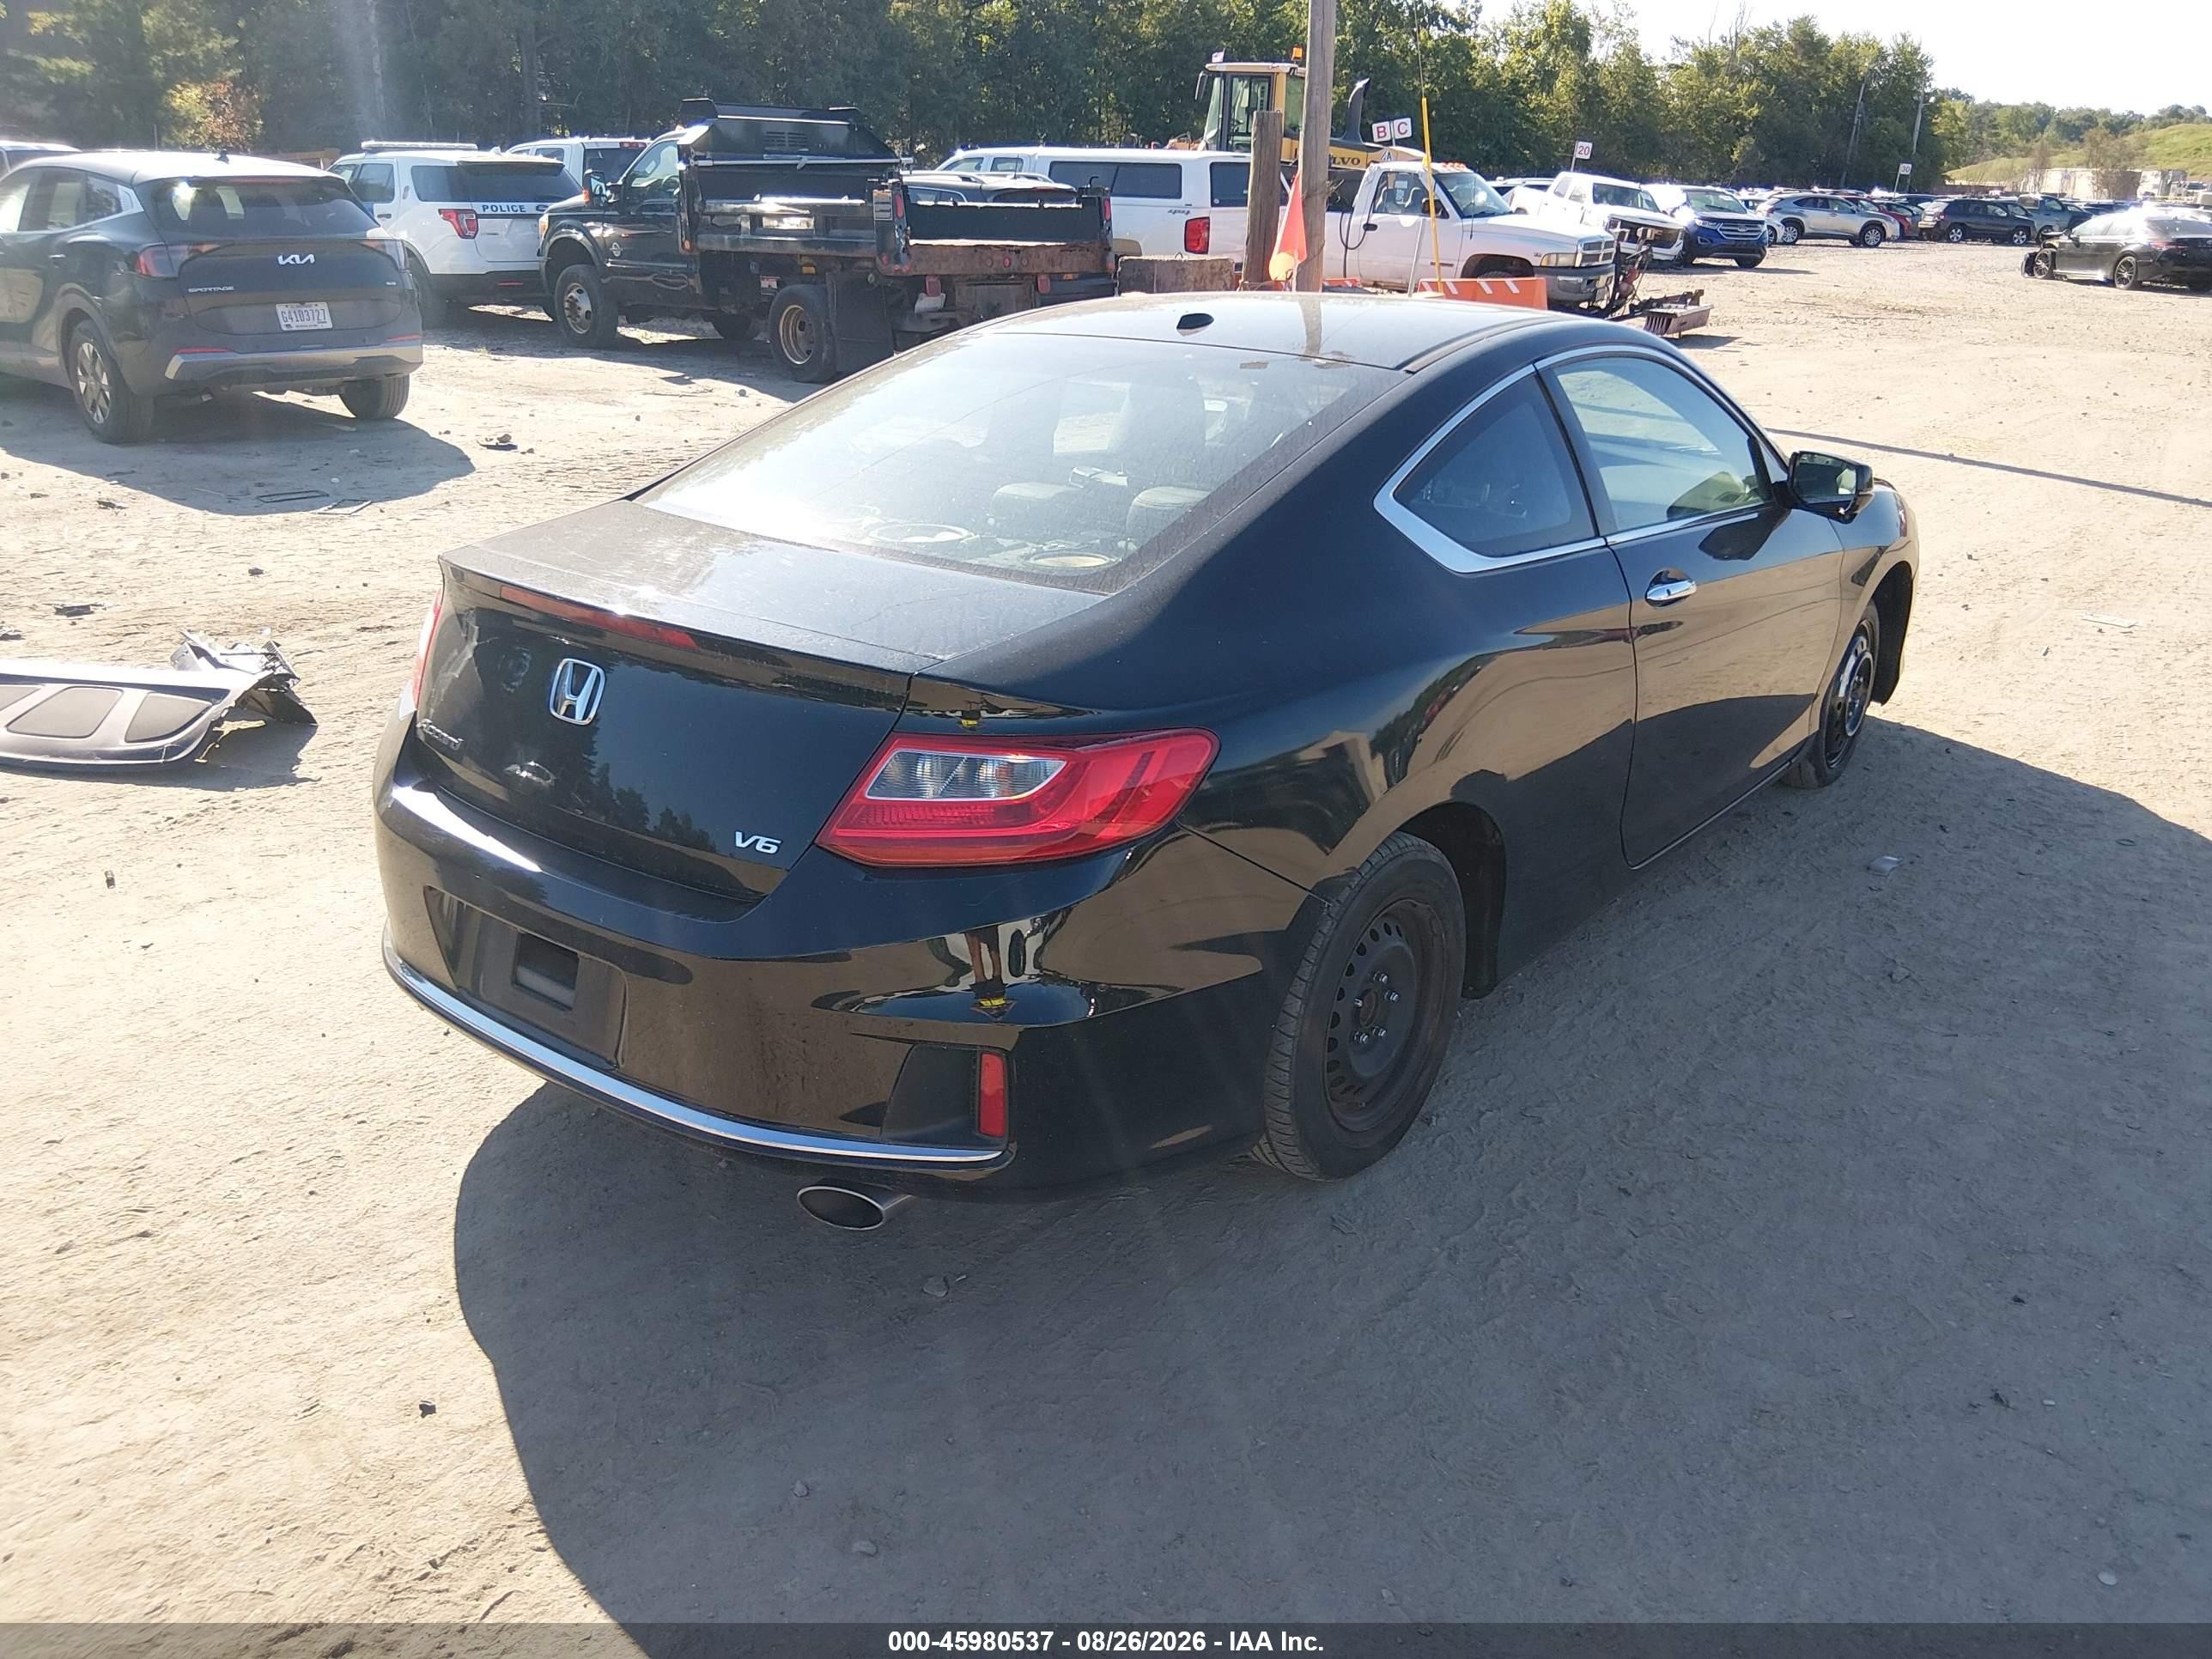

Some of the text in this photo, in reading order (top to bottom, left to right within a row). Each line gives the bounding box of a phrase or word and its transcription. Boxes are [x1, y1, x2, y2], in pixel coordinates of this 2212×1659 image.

[1376, 125, 1387, 138] B
[1397, 122, 1407, 136] C
[1578, 145, 1589, 155] 20
[482, 204, 526, 213] POLICE
[277, 254, 315, 265] KIA
[735, 831, 782, 854] V6
